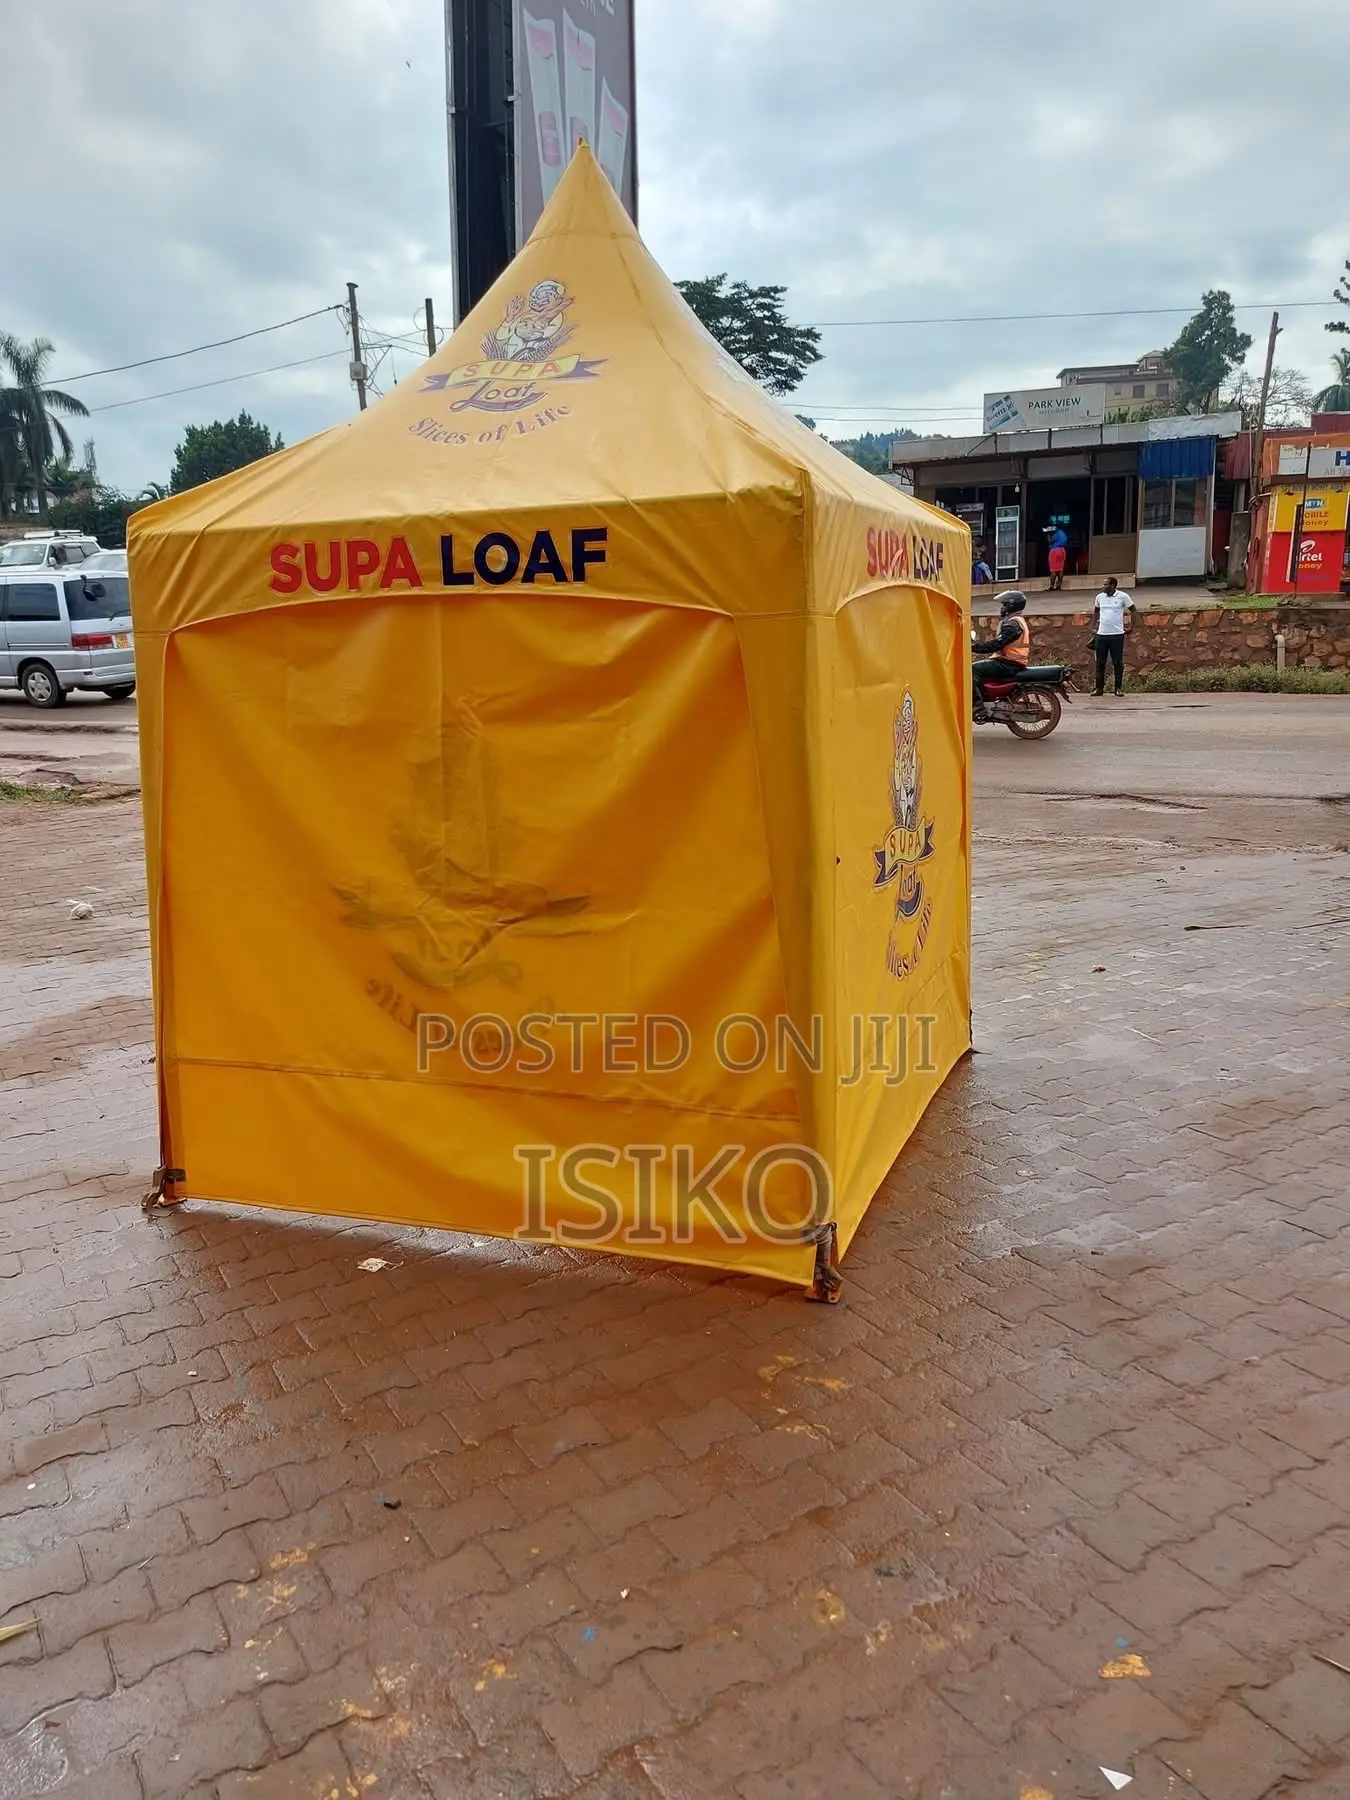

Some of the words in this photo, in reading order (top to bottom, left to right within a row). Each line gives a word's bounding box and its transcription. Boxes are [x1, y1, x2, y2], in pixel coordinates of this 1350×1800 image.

[463, 360, 561, 377] SUPA
[450, 380, 548, 412] Loaf
[1028, 399, 1053, 410] PARK
[1056, 396, 1081, 407] VIEW
[408, 417, 469, 445] Slices
[478, 422, 509, 445] of
[1304, 511, 1329, 519] OBILE
[1304, 519, 1329, 527] oney
[269, 536, 424, 595] SUPA
[439, 527, 609, 587] LOAF
[866, 527, 909, 578] SUPA
[912, 535, 944, 582] LOAF
[1296, 563, 1323, 571] oney
[889, 830, 922, 858] SUPA
